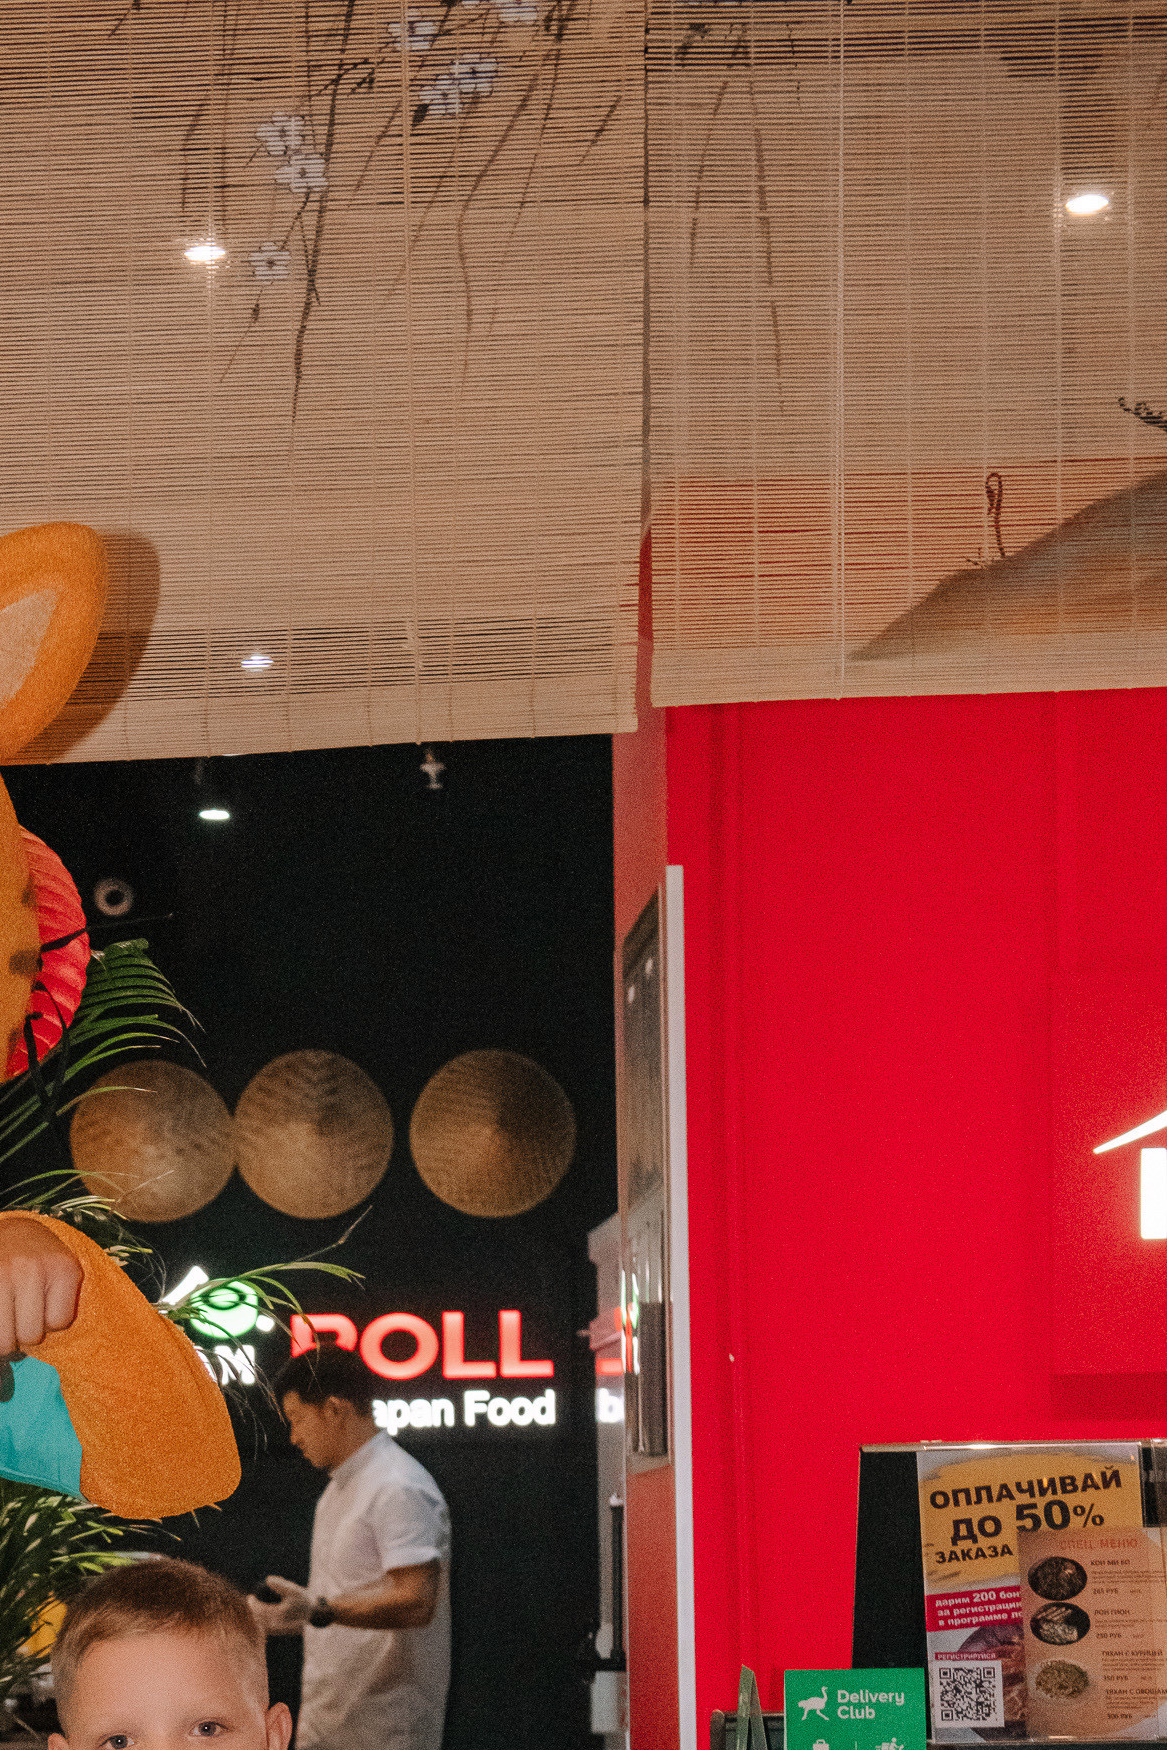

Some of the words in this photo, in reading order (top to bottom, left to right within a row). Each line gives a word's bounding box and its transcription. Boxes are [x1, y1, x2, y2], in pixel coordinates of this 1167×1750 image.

[463, 1388, 556, 1427] Food
[929, 1465, 1122, 1509] ОПЛАЧИВАЙ
[950, 1515, 1002, 1546] ДО
[1015, 1499, 1105, 1533] 50%
[935, 1544, 1013, 1564] ЗАКАЗА
[935, 1597, 970, 1607] дарим
[972, 1591, 996, 1602] 200
[947, 1612, 1008, 1626] программе
[837, 1689, 905, 1706] Delivery
[837, 1705, 875, 1719] Club
